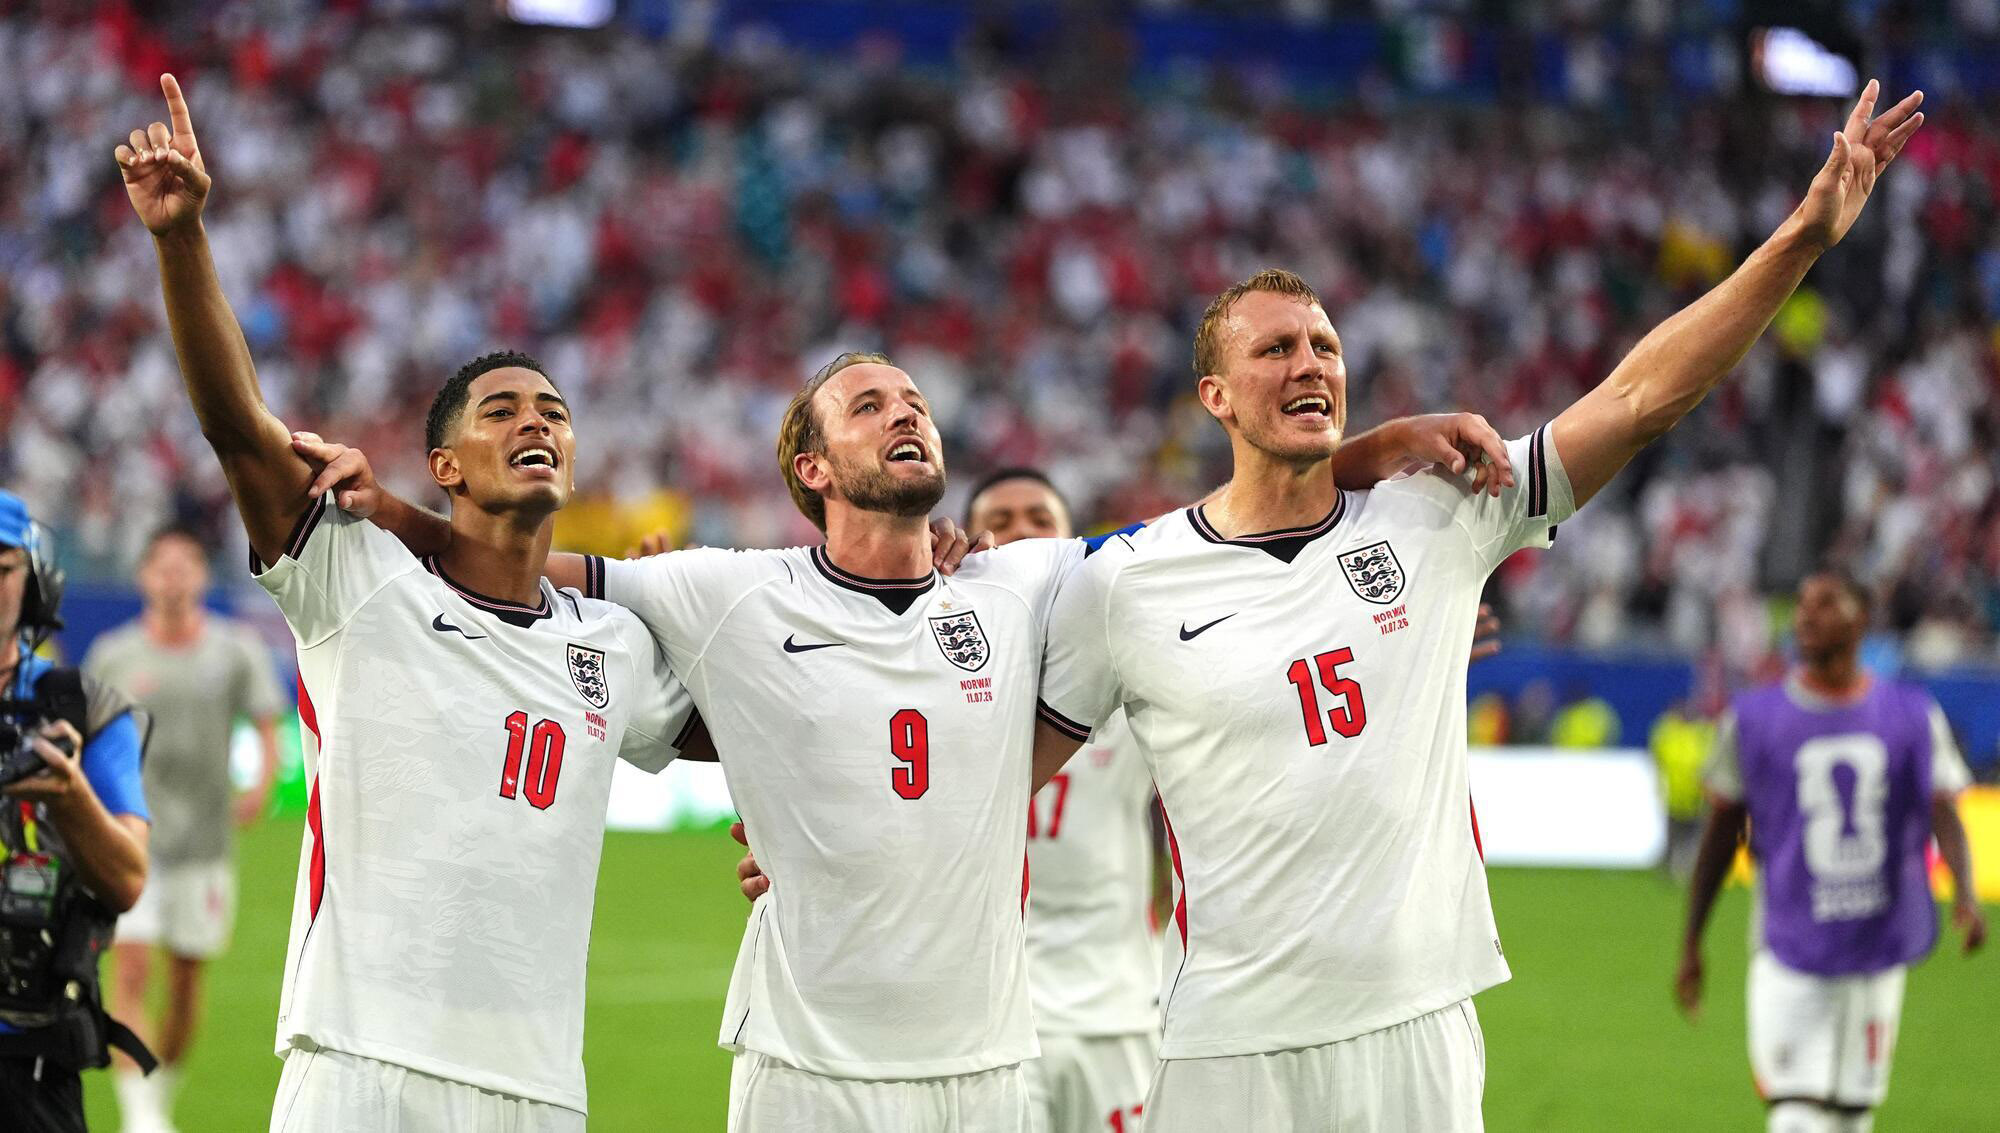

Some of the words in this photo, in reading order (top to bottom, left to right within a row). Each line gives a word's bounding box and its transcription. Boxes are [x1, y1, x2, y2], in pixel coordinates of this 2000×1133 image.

[1373, 604, 1406, 624] NORWAY
[1380, 618, 1409, 635] 11.07.26
[960, 677, 992, 690] NORWAY
[966, 691, 993, 703] 11.07.26
[1287, 646, 1367, 747] 15
[585, 711, 607, 730] NORWAY
[499, 710, 566, 811] 10
[890, 709, 929, 800] 9
